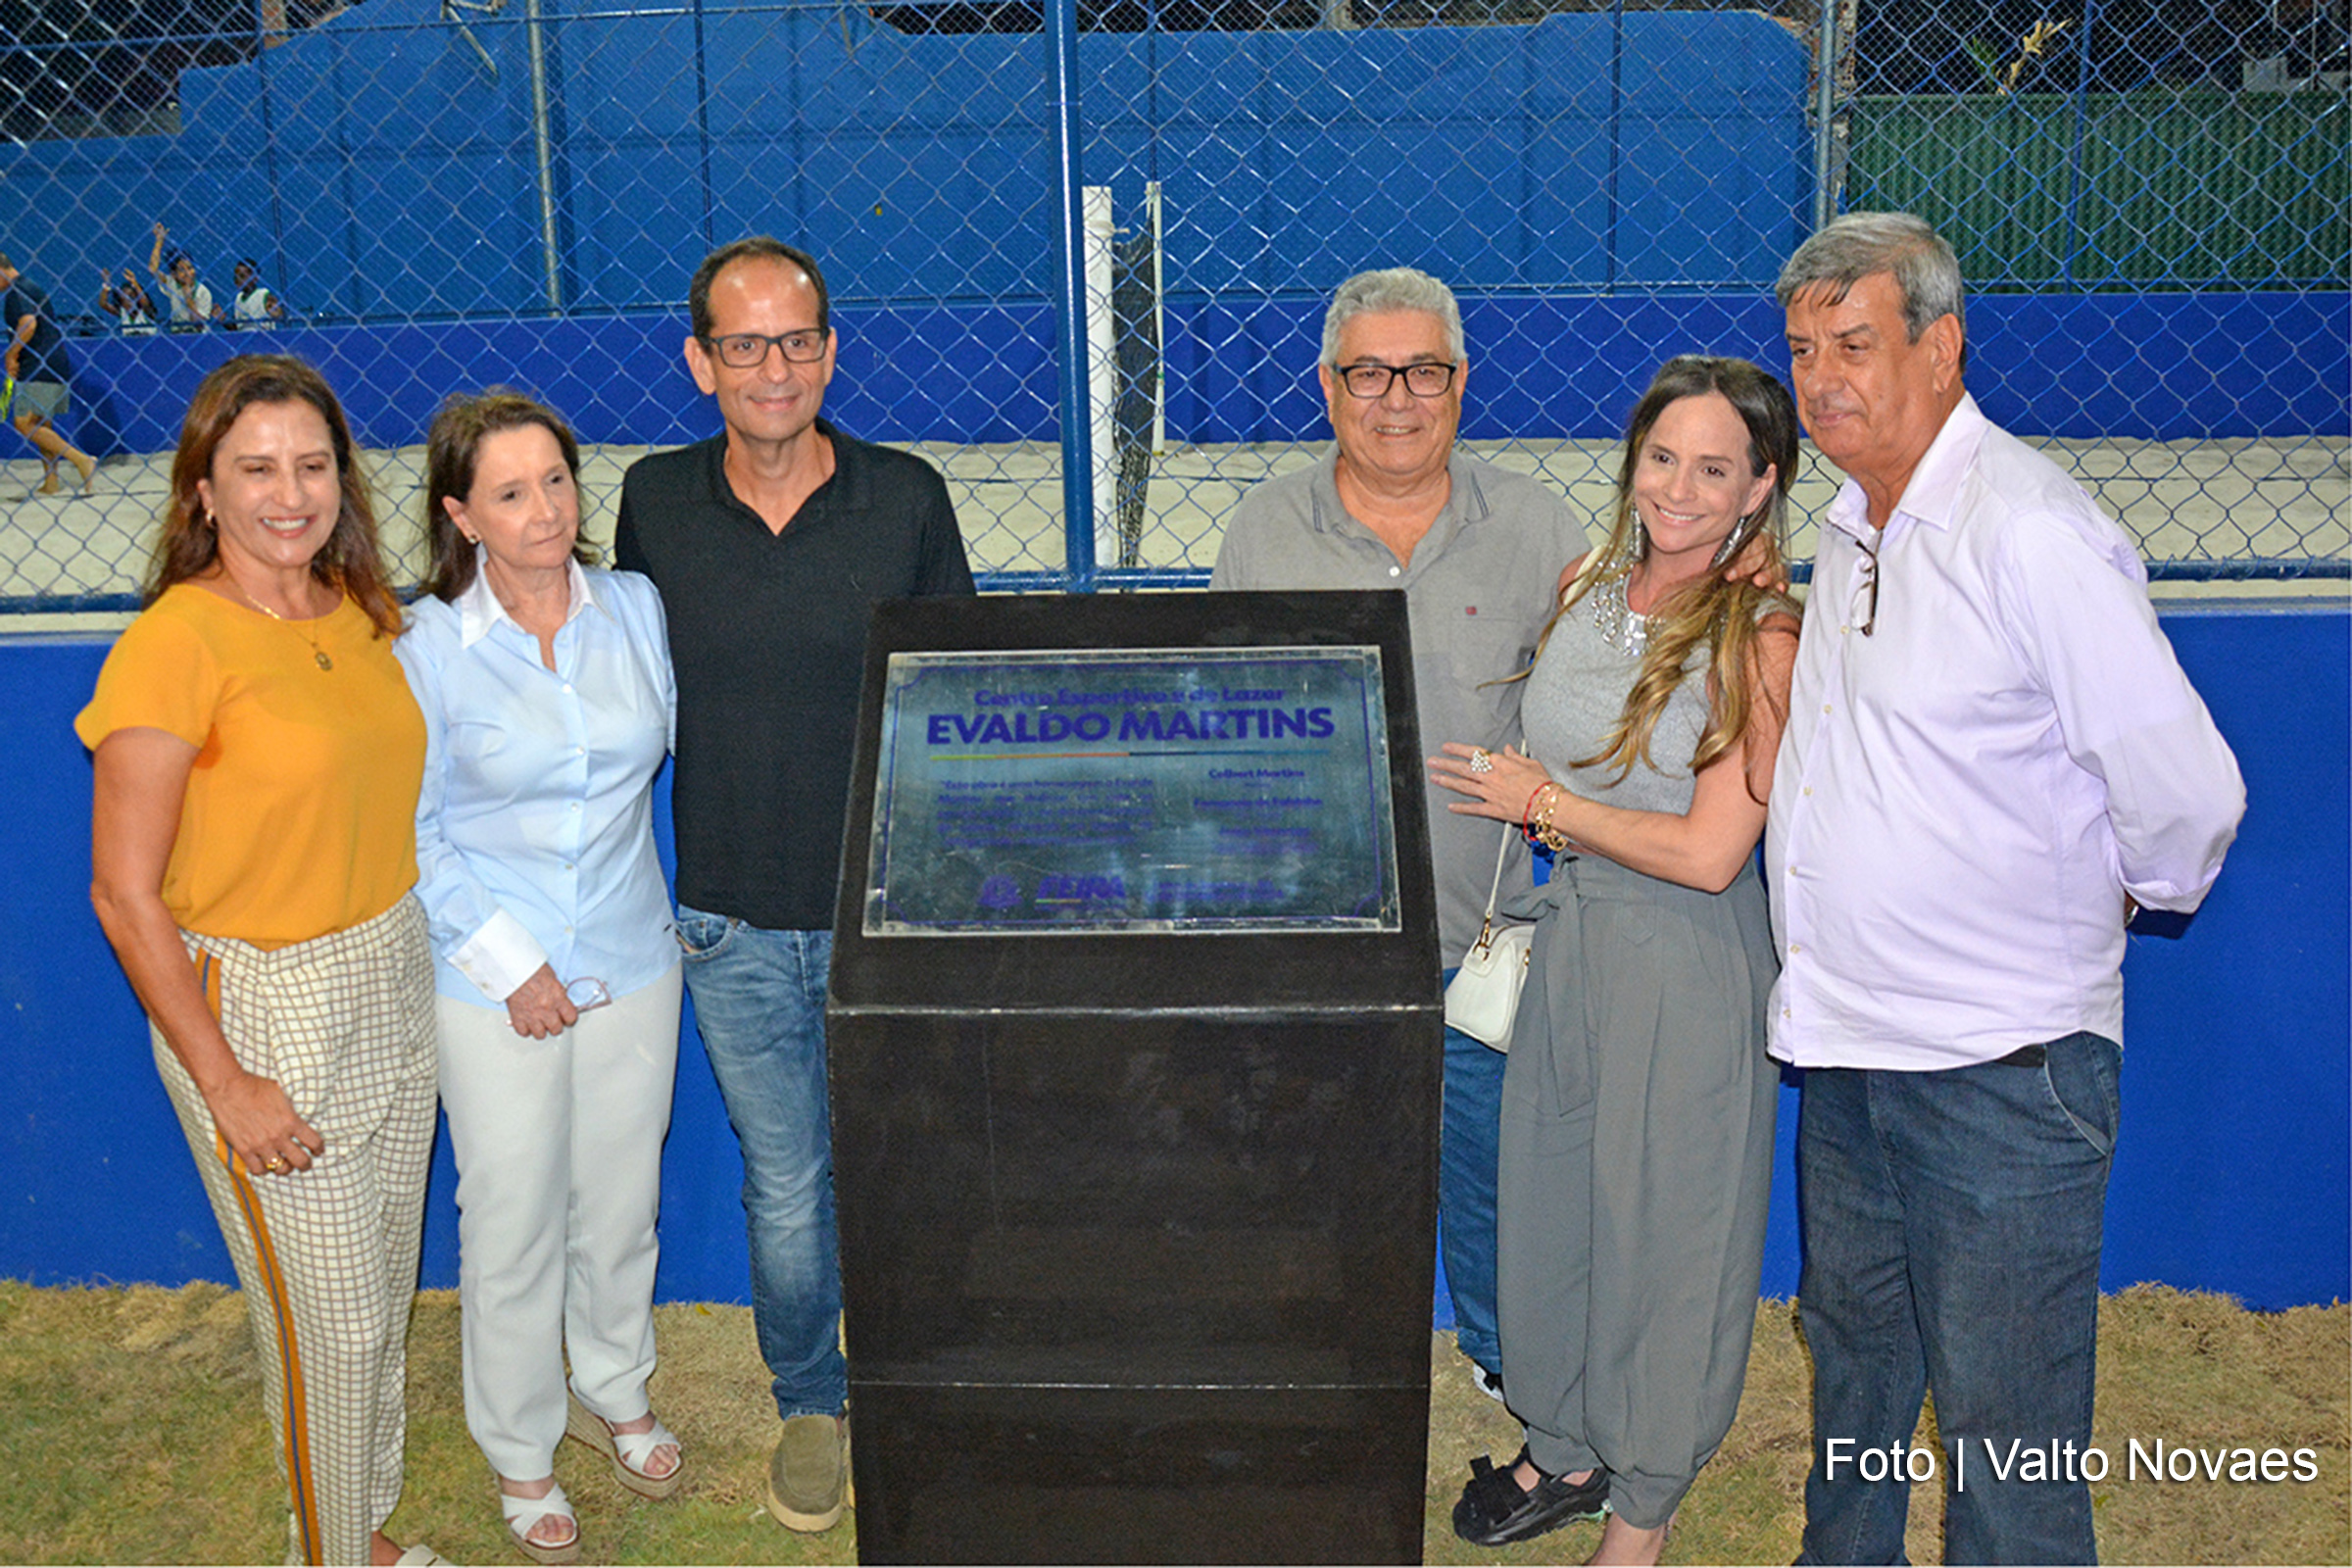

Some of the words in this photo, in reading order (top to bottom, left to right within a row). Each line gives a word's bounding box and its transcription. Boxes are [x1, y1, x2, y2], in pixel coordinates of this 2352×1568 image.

[974, 689, 1054, 706] Centro
[1057, 687, 1168, 707] Esportivo
[1222, 685, 1286, 702] Lazer
[926, 711, 1111, 745] EVALDO
[1118, 708, 1336, 742] MARTINS
[1208, 768, 1254, 779] Colbert
[1256, 768, 1305, 778] Martins
